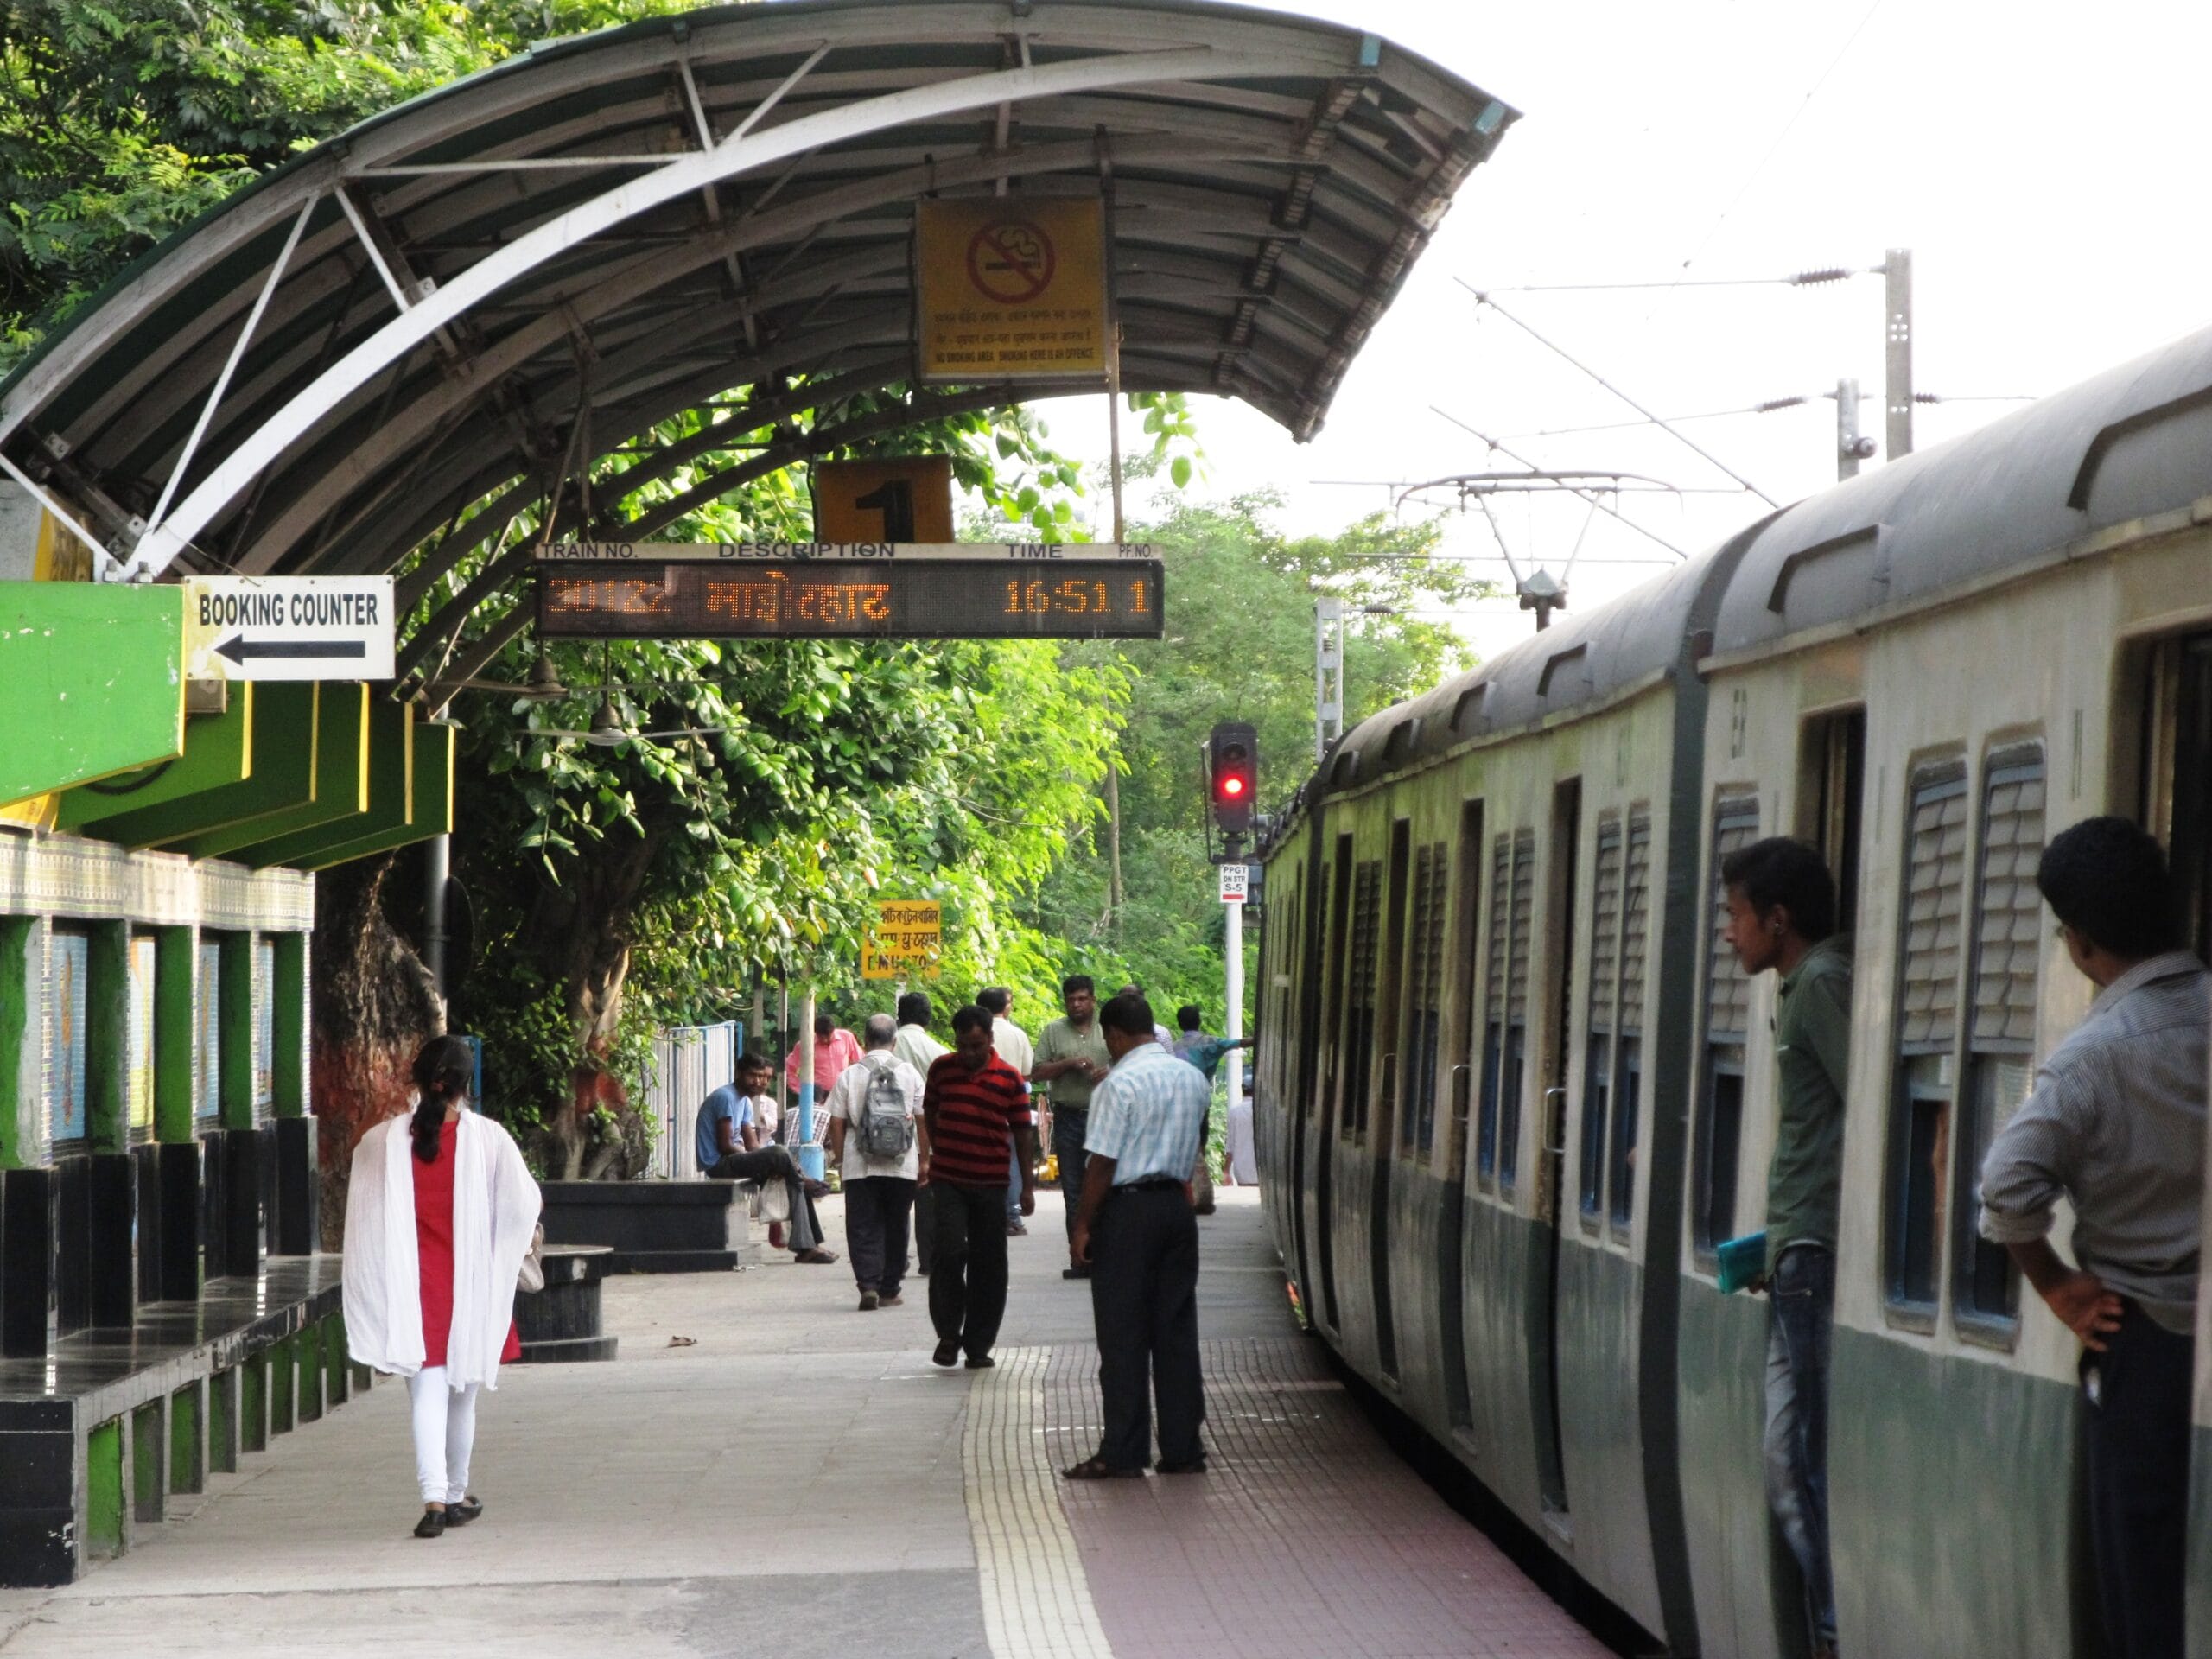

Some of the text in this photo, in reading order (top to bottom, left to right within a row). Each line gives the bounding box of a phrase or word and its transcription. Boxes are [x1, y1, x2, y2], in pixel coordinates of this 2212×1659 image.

[855, 479, 914, 543] 1
[542, 543, 638, 558] TRAIN NO.
[719, 543, 895, 558] DESCRIPTION
[1006, 543, 1063, 558] TIME
[200, 593, 378, 626] BOOKING COUNTER
[1004, 581, 1112, 613] 16:51
[1130, 581, 1151, 613] 1
